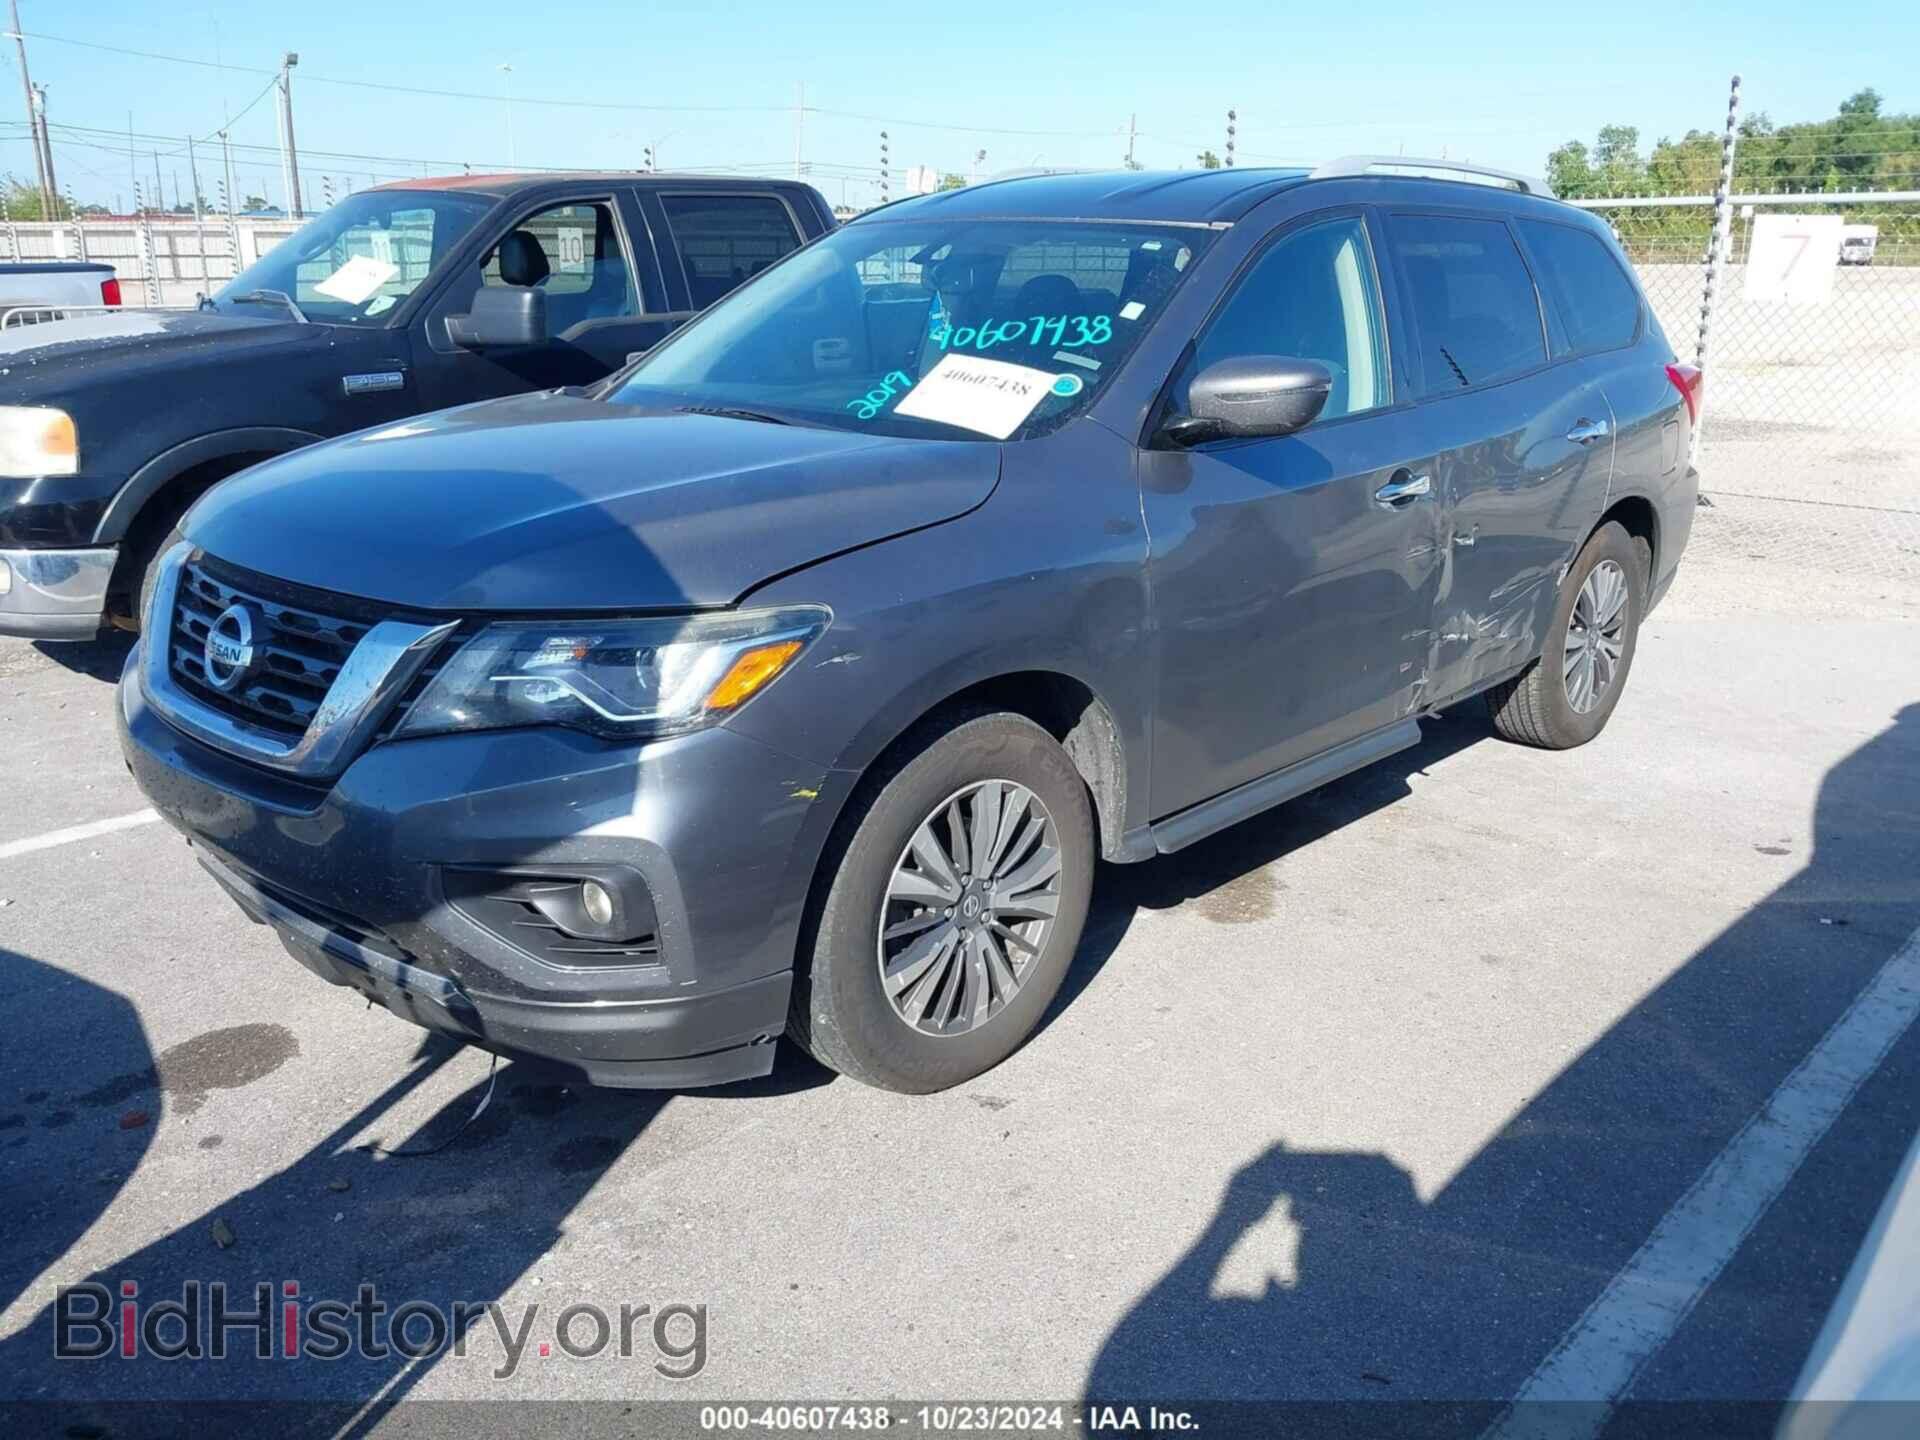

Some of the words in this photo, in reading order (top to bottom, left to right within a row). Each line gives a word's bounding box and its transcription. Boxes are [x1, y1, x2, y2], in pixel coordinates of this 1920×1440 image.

[560, 236, 582, 263] 10
[1779, 234, 1812, 281] 7
[930, 314, 1113, 350] 40607438
[846, 369, 913, 420] 2019
